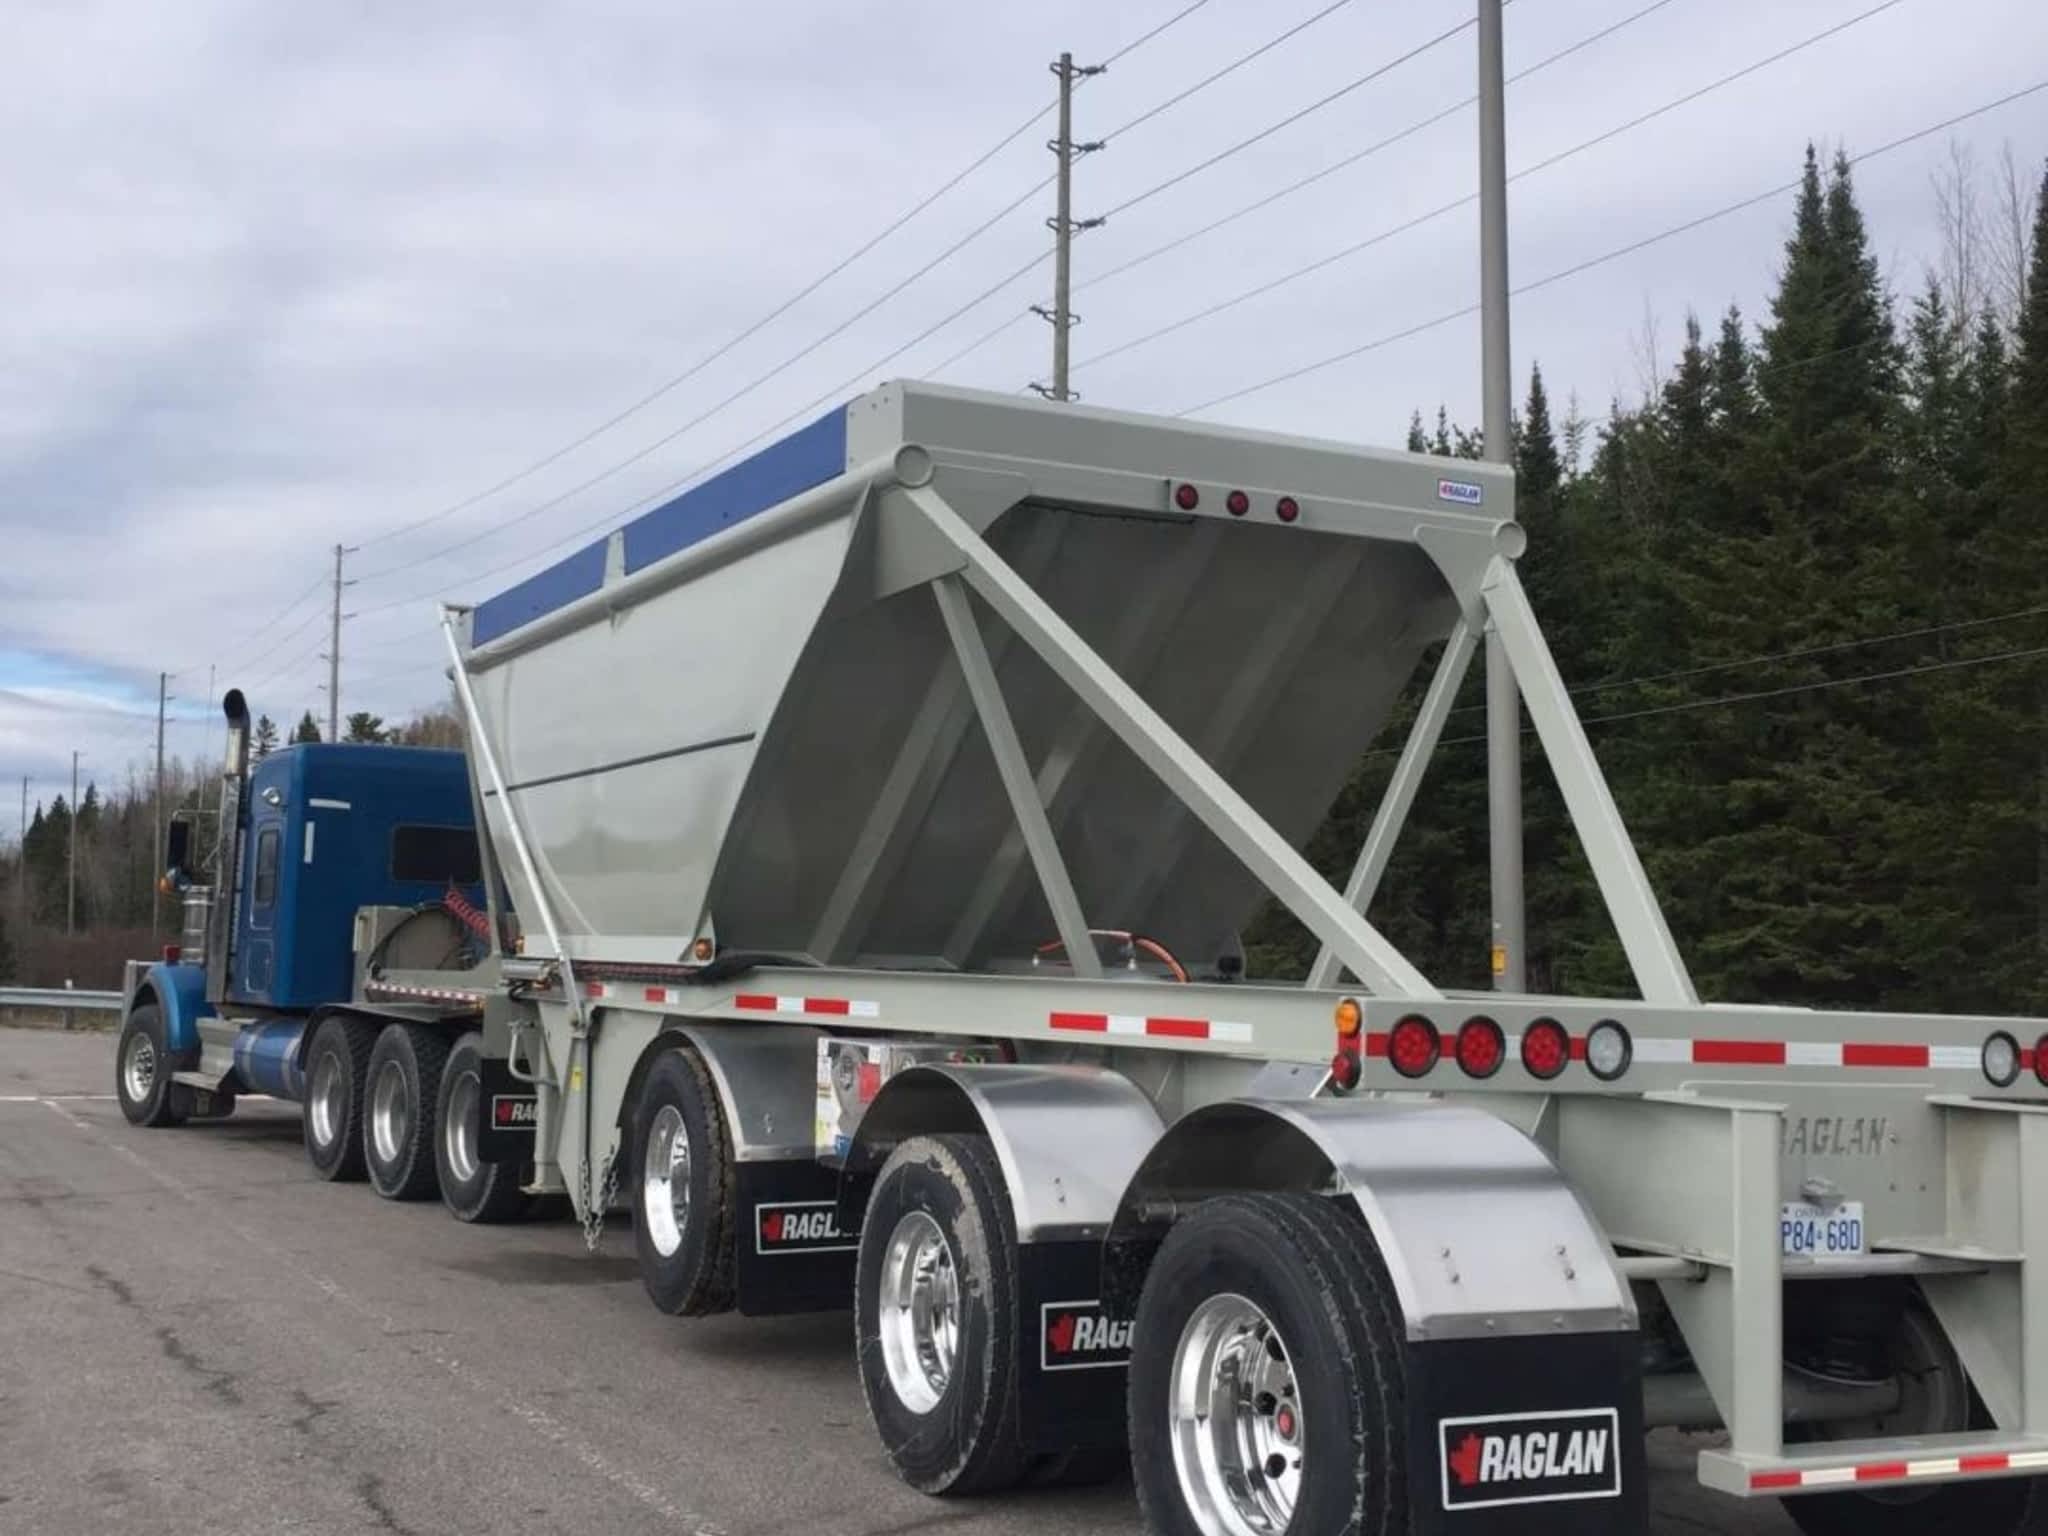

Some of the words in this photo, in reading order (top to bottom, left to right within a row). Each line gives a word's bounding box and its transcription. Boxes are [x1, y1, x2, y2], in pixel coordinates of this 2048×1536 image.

[782, 1212, 862, 1240] RAGL
[1781, 1220, 1815, 1251] P84
[1827, 1219, 1861, 1251] 68D
[1479, 1429, 1608, 1483] RAGLAN
